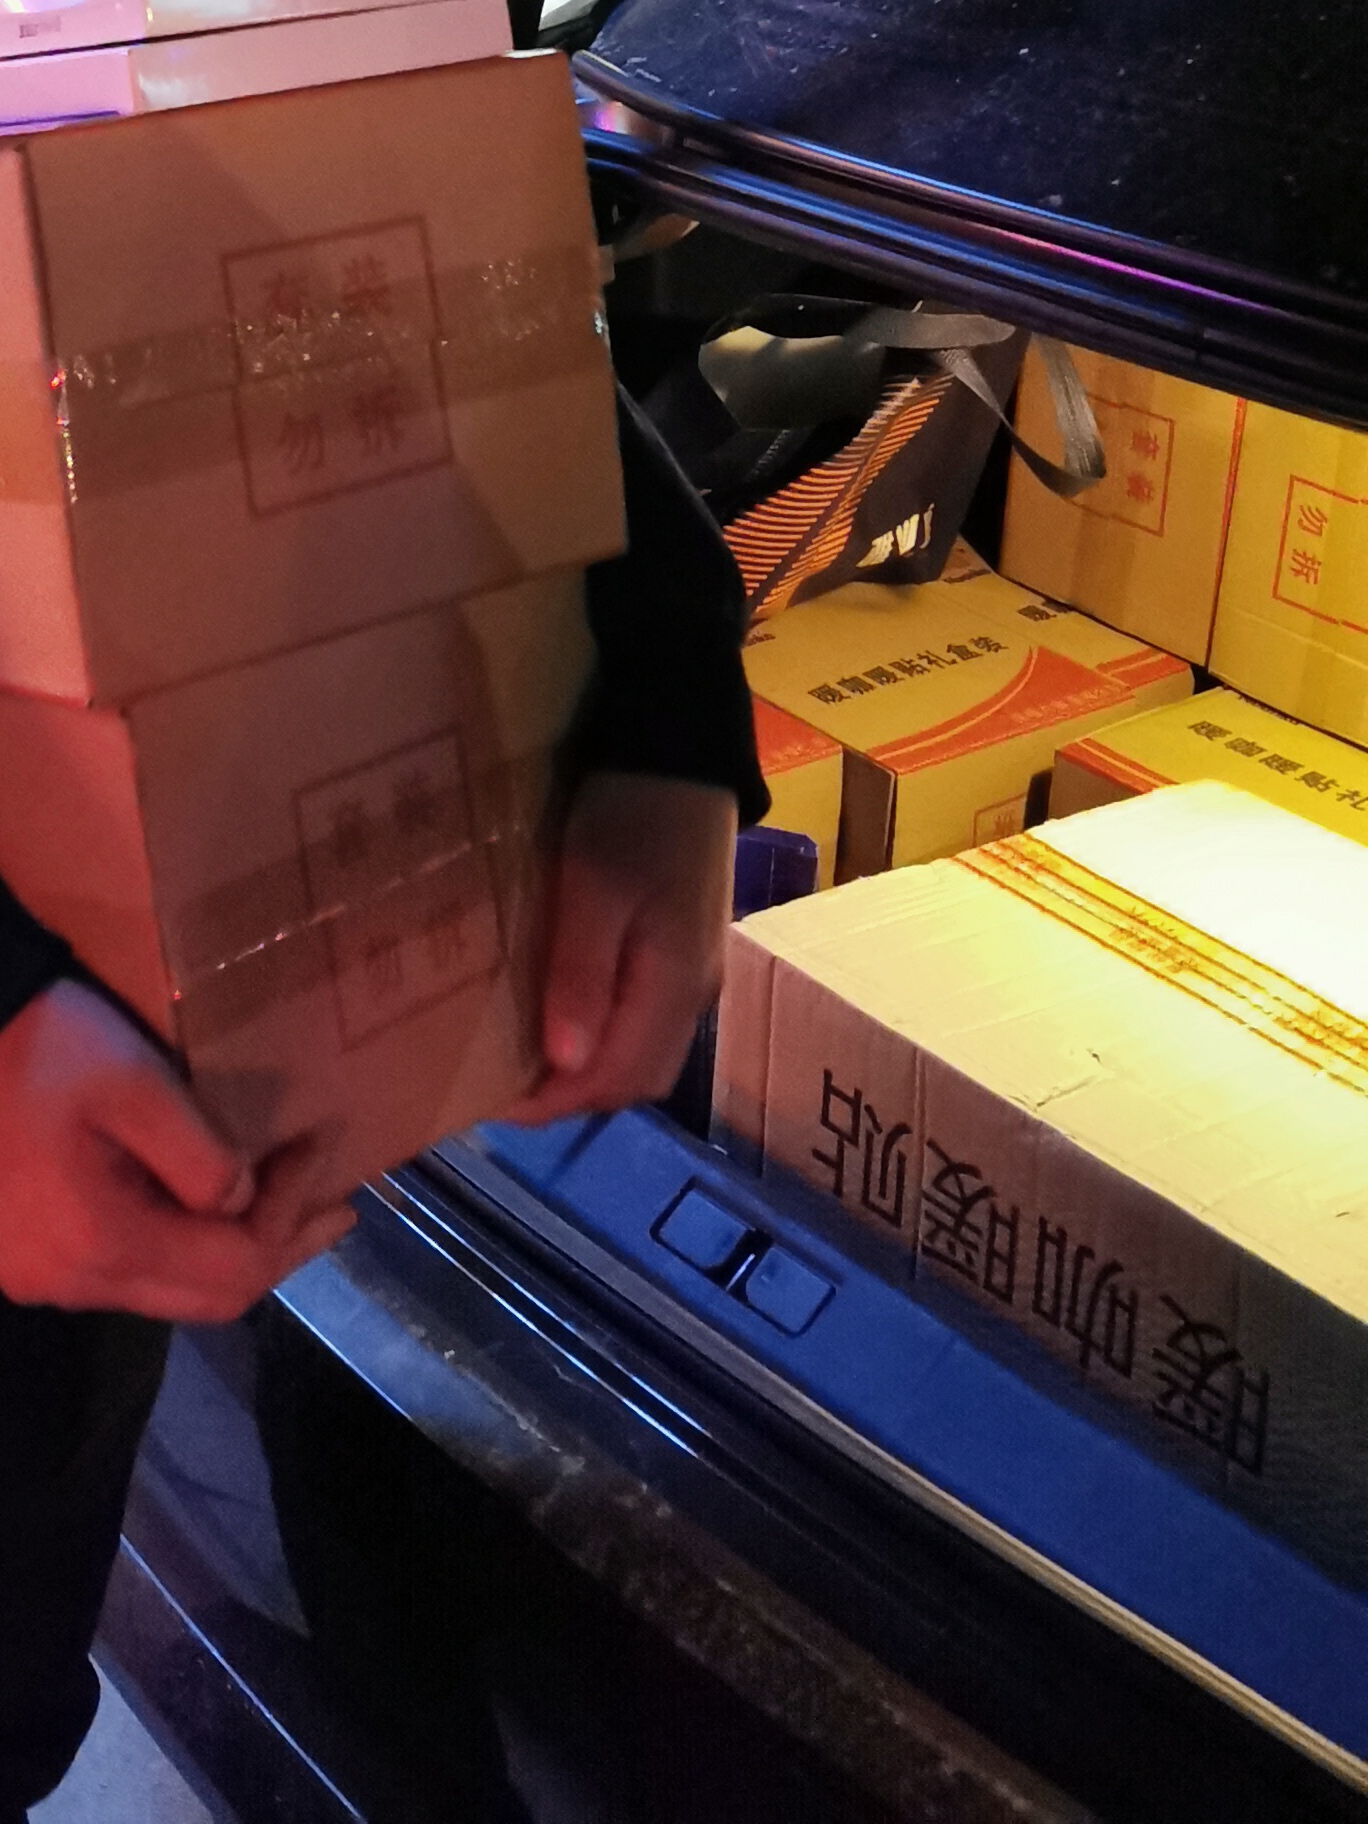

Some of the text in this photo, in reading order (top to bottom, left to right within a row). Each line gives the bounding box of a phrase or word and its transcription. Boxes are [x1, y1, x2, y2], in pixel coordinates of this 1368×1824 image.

[1290, 504, 1328, 585] 勿拆
[812, 1068, 1270, 1474] 暖咖暖贴
